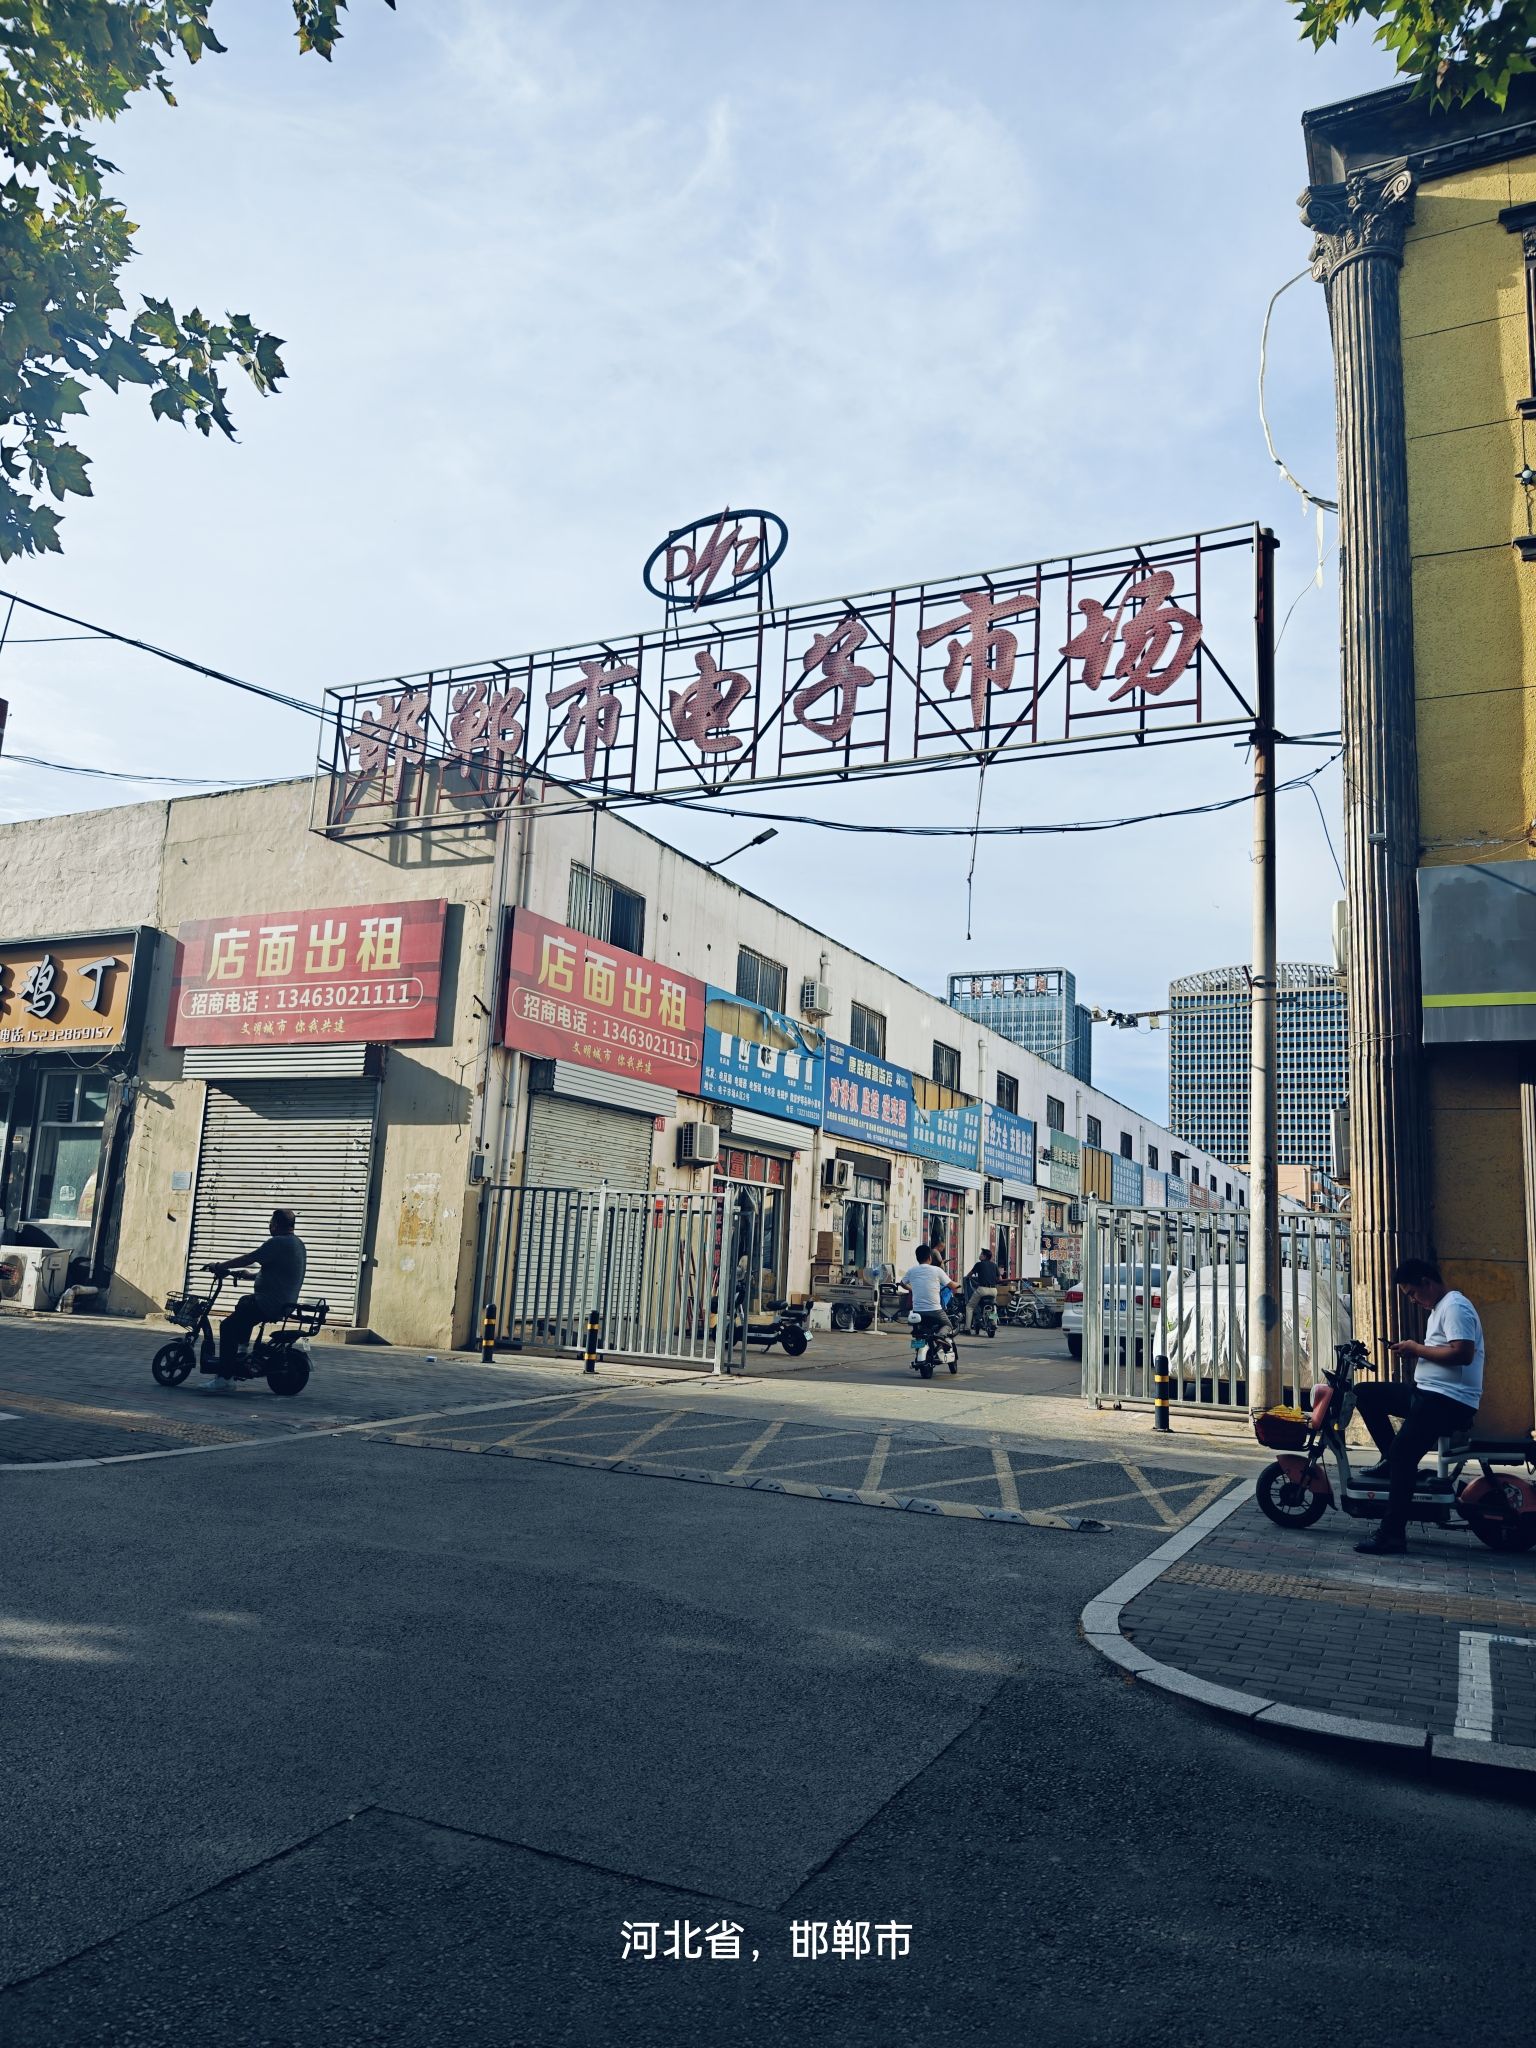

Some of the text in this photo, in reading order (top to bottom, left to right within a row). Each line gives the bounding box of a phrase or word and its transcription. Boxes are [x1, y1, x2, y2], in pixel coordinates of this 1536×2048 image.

[345, 570, 1203, 801] 邯郸市电子市场
[206, 916, 403, 982] 店面出租
[0, 954, 116, 1018] 鸡丁
[537, 933, 687, 1032] 店面出租
[240, 1015, 347, 1035] 文明城市 你我共建
[571, 1041, 653, 1076] 文明城市 你我共建
[829, 1076, 859, 1112] 对讲机
[860, 1086, 880, 1120] 监控
